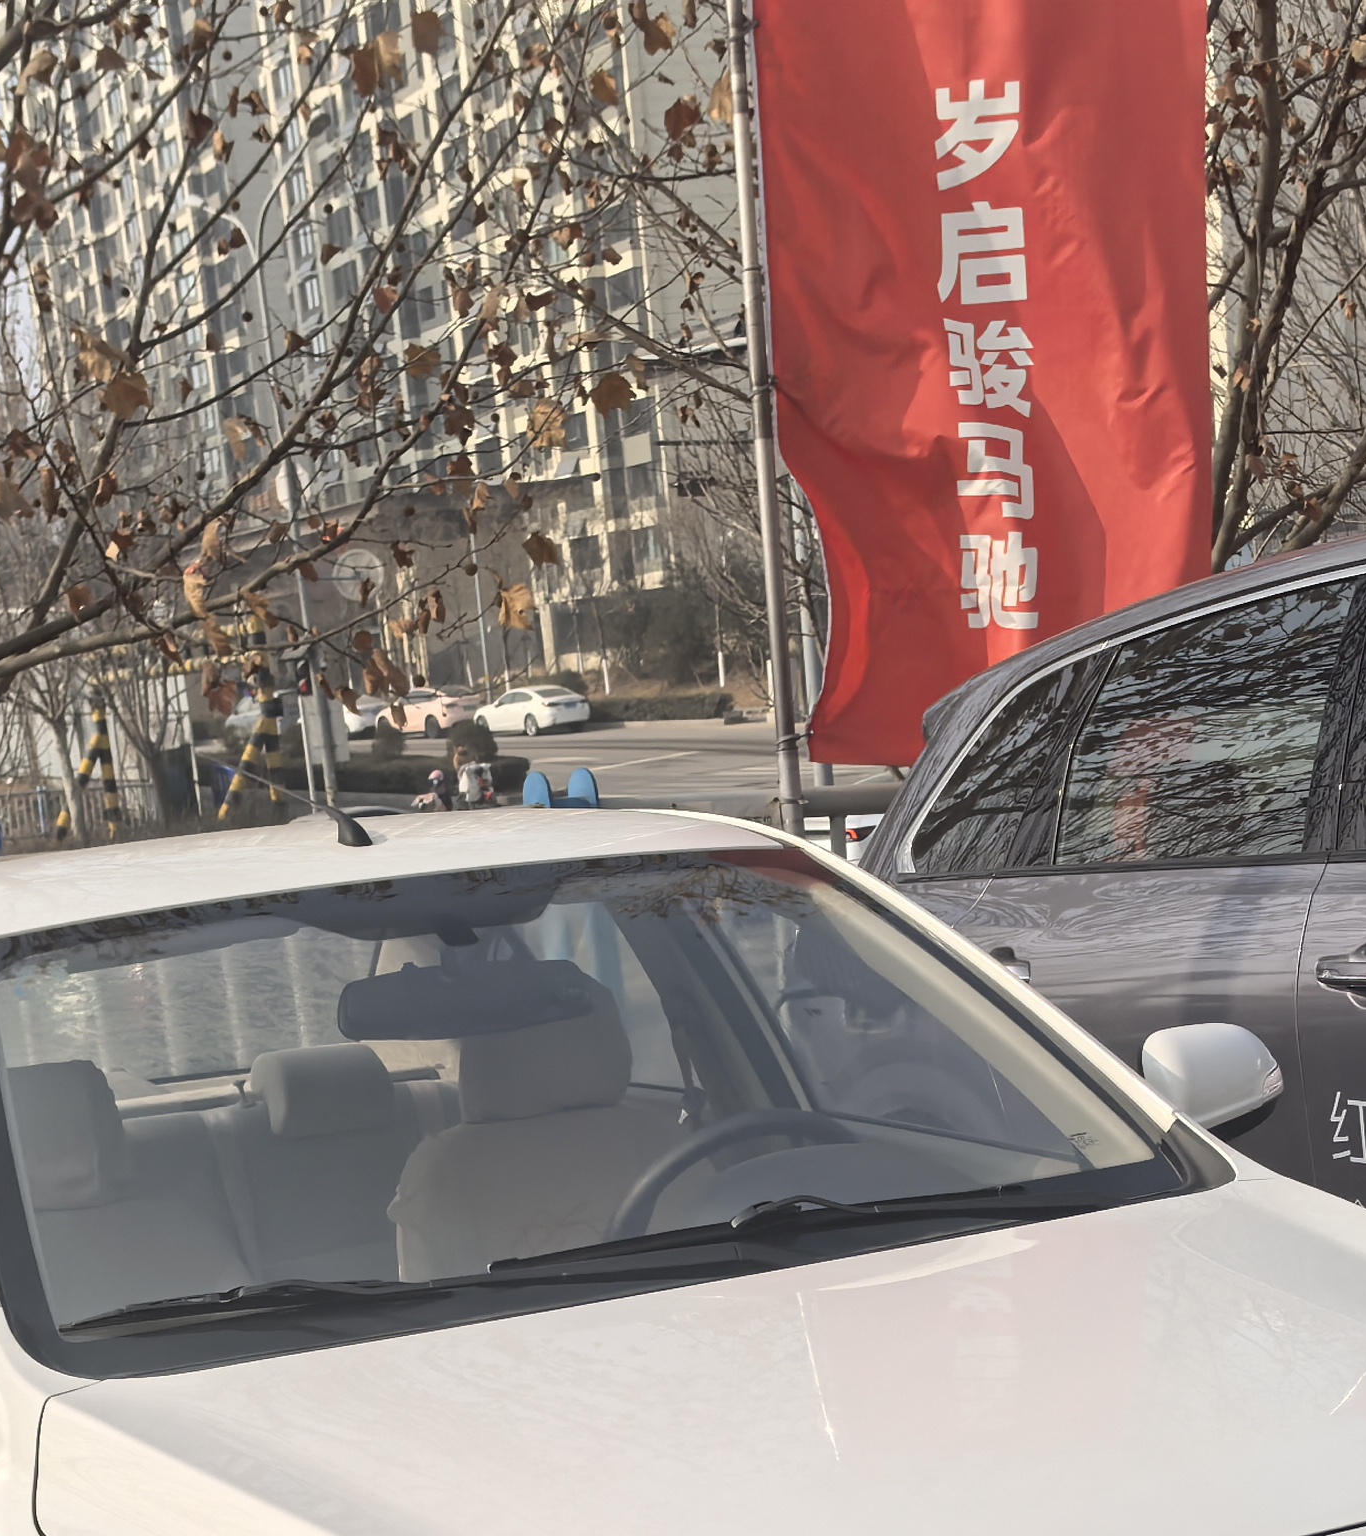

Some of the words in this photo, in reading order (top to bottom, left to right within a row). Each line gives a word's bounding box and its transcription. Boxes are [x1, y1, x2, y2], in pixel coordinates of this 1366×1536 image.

[935, 79, 1039, 630] 岁启骏马驰
